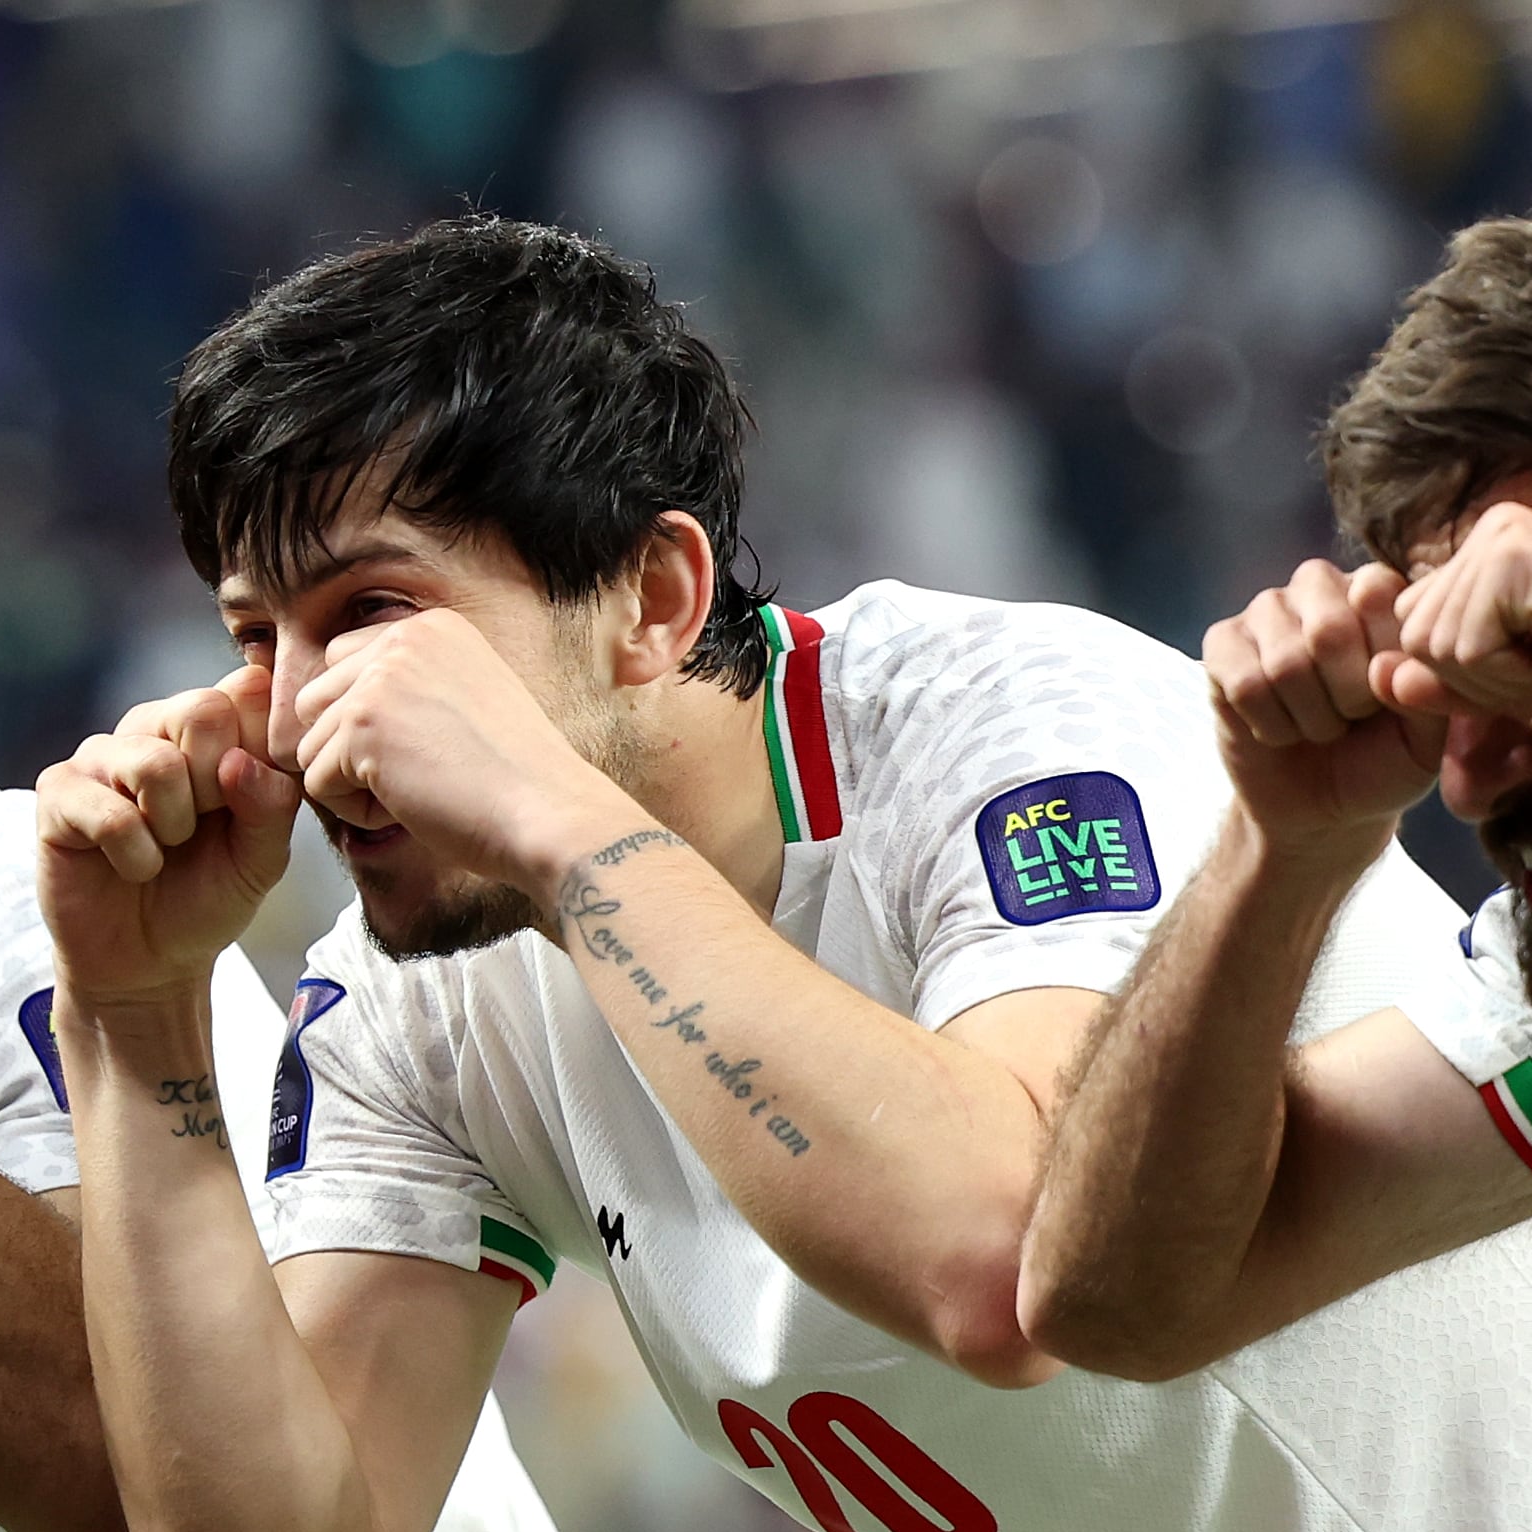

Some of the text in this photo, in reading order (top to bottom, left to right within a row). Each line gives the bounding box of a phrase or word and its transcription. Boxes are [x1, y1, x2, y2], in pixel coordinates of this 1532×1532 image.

[1004, 799, 1072, 837] AFC
[1006, 818, 1129, 871] LIVE
[628, 967, 667, 1005] me
[651, 1001, 707, 1044] for
[706, 1052, 763, 1099] who
